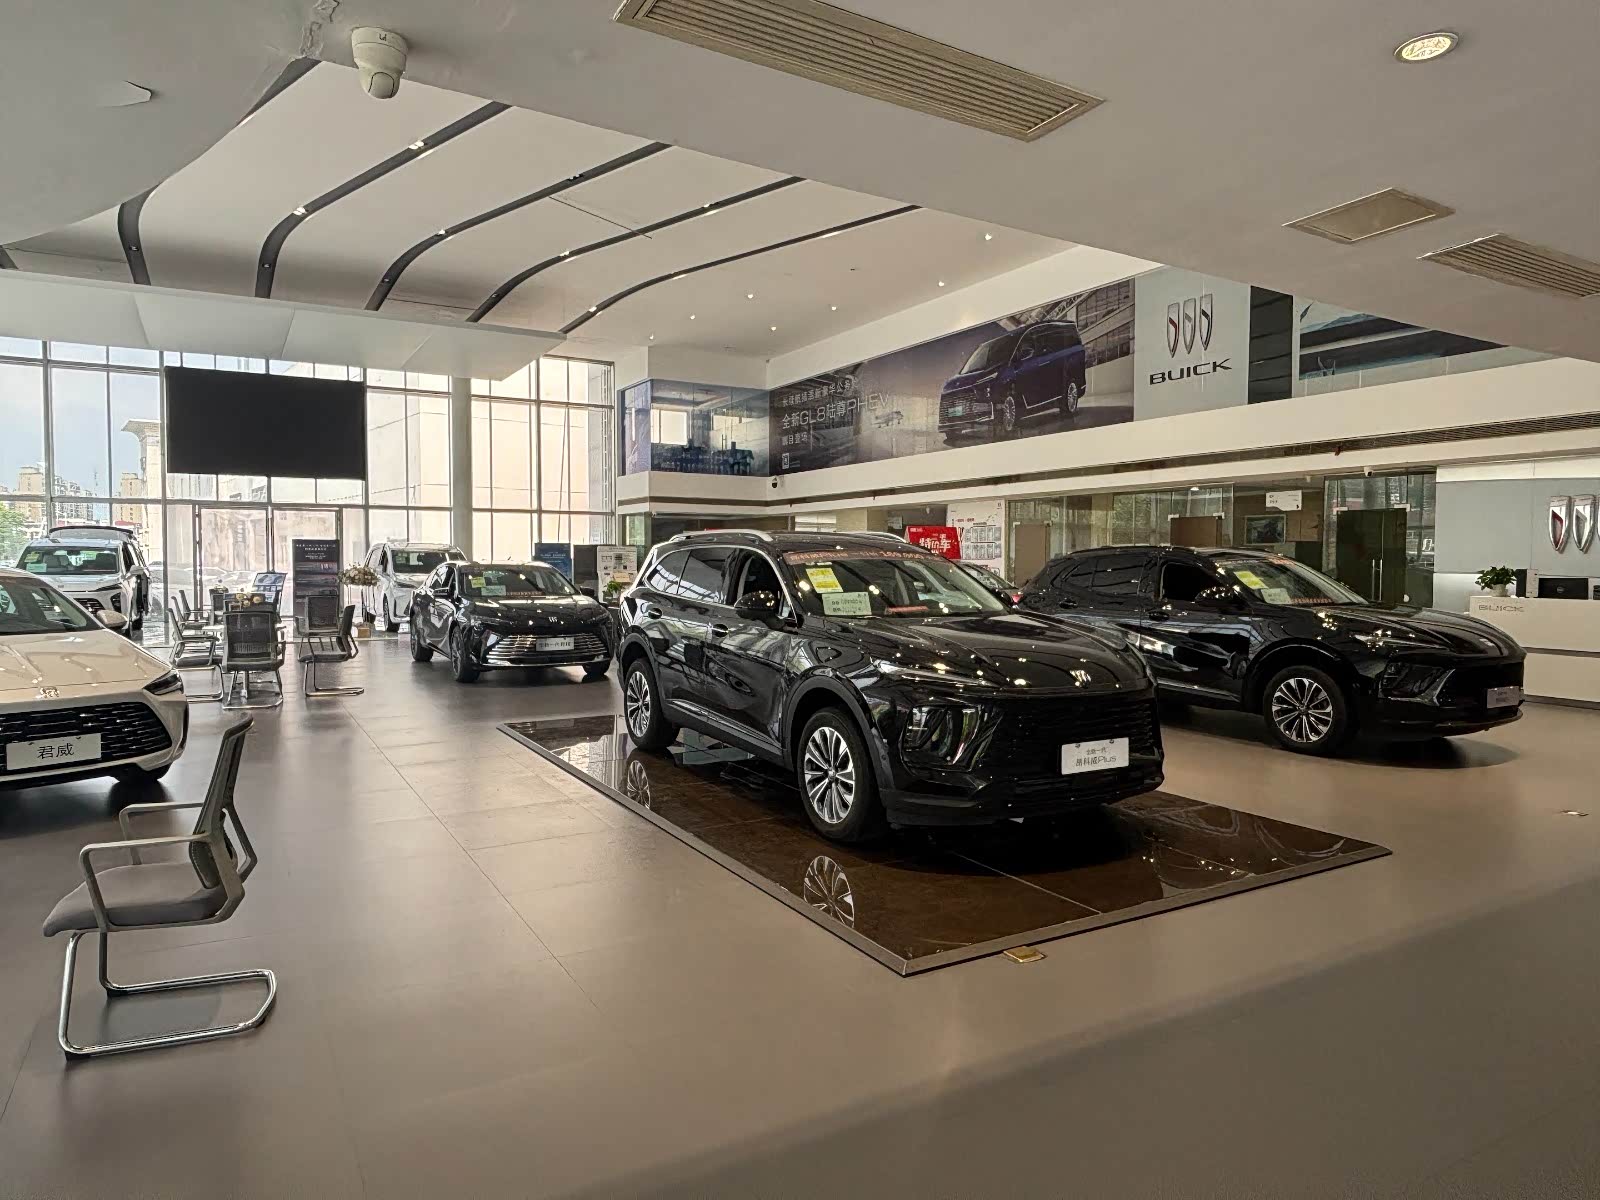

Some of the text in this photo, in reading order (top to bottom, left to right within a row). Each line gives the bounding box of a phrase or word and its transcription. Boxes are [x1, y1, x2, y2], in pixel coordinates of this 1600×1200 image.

[1150, 358, 1232, 385] BUICK
[1478, 604, 1525, 612] BUICK
[37, 742, 74, 760] 君威
